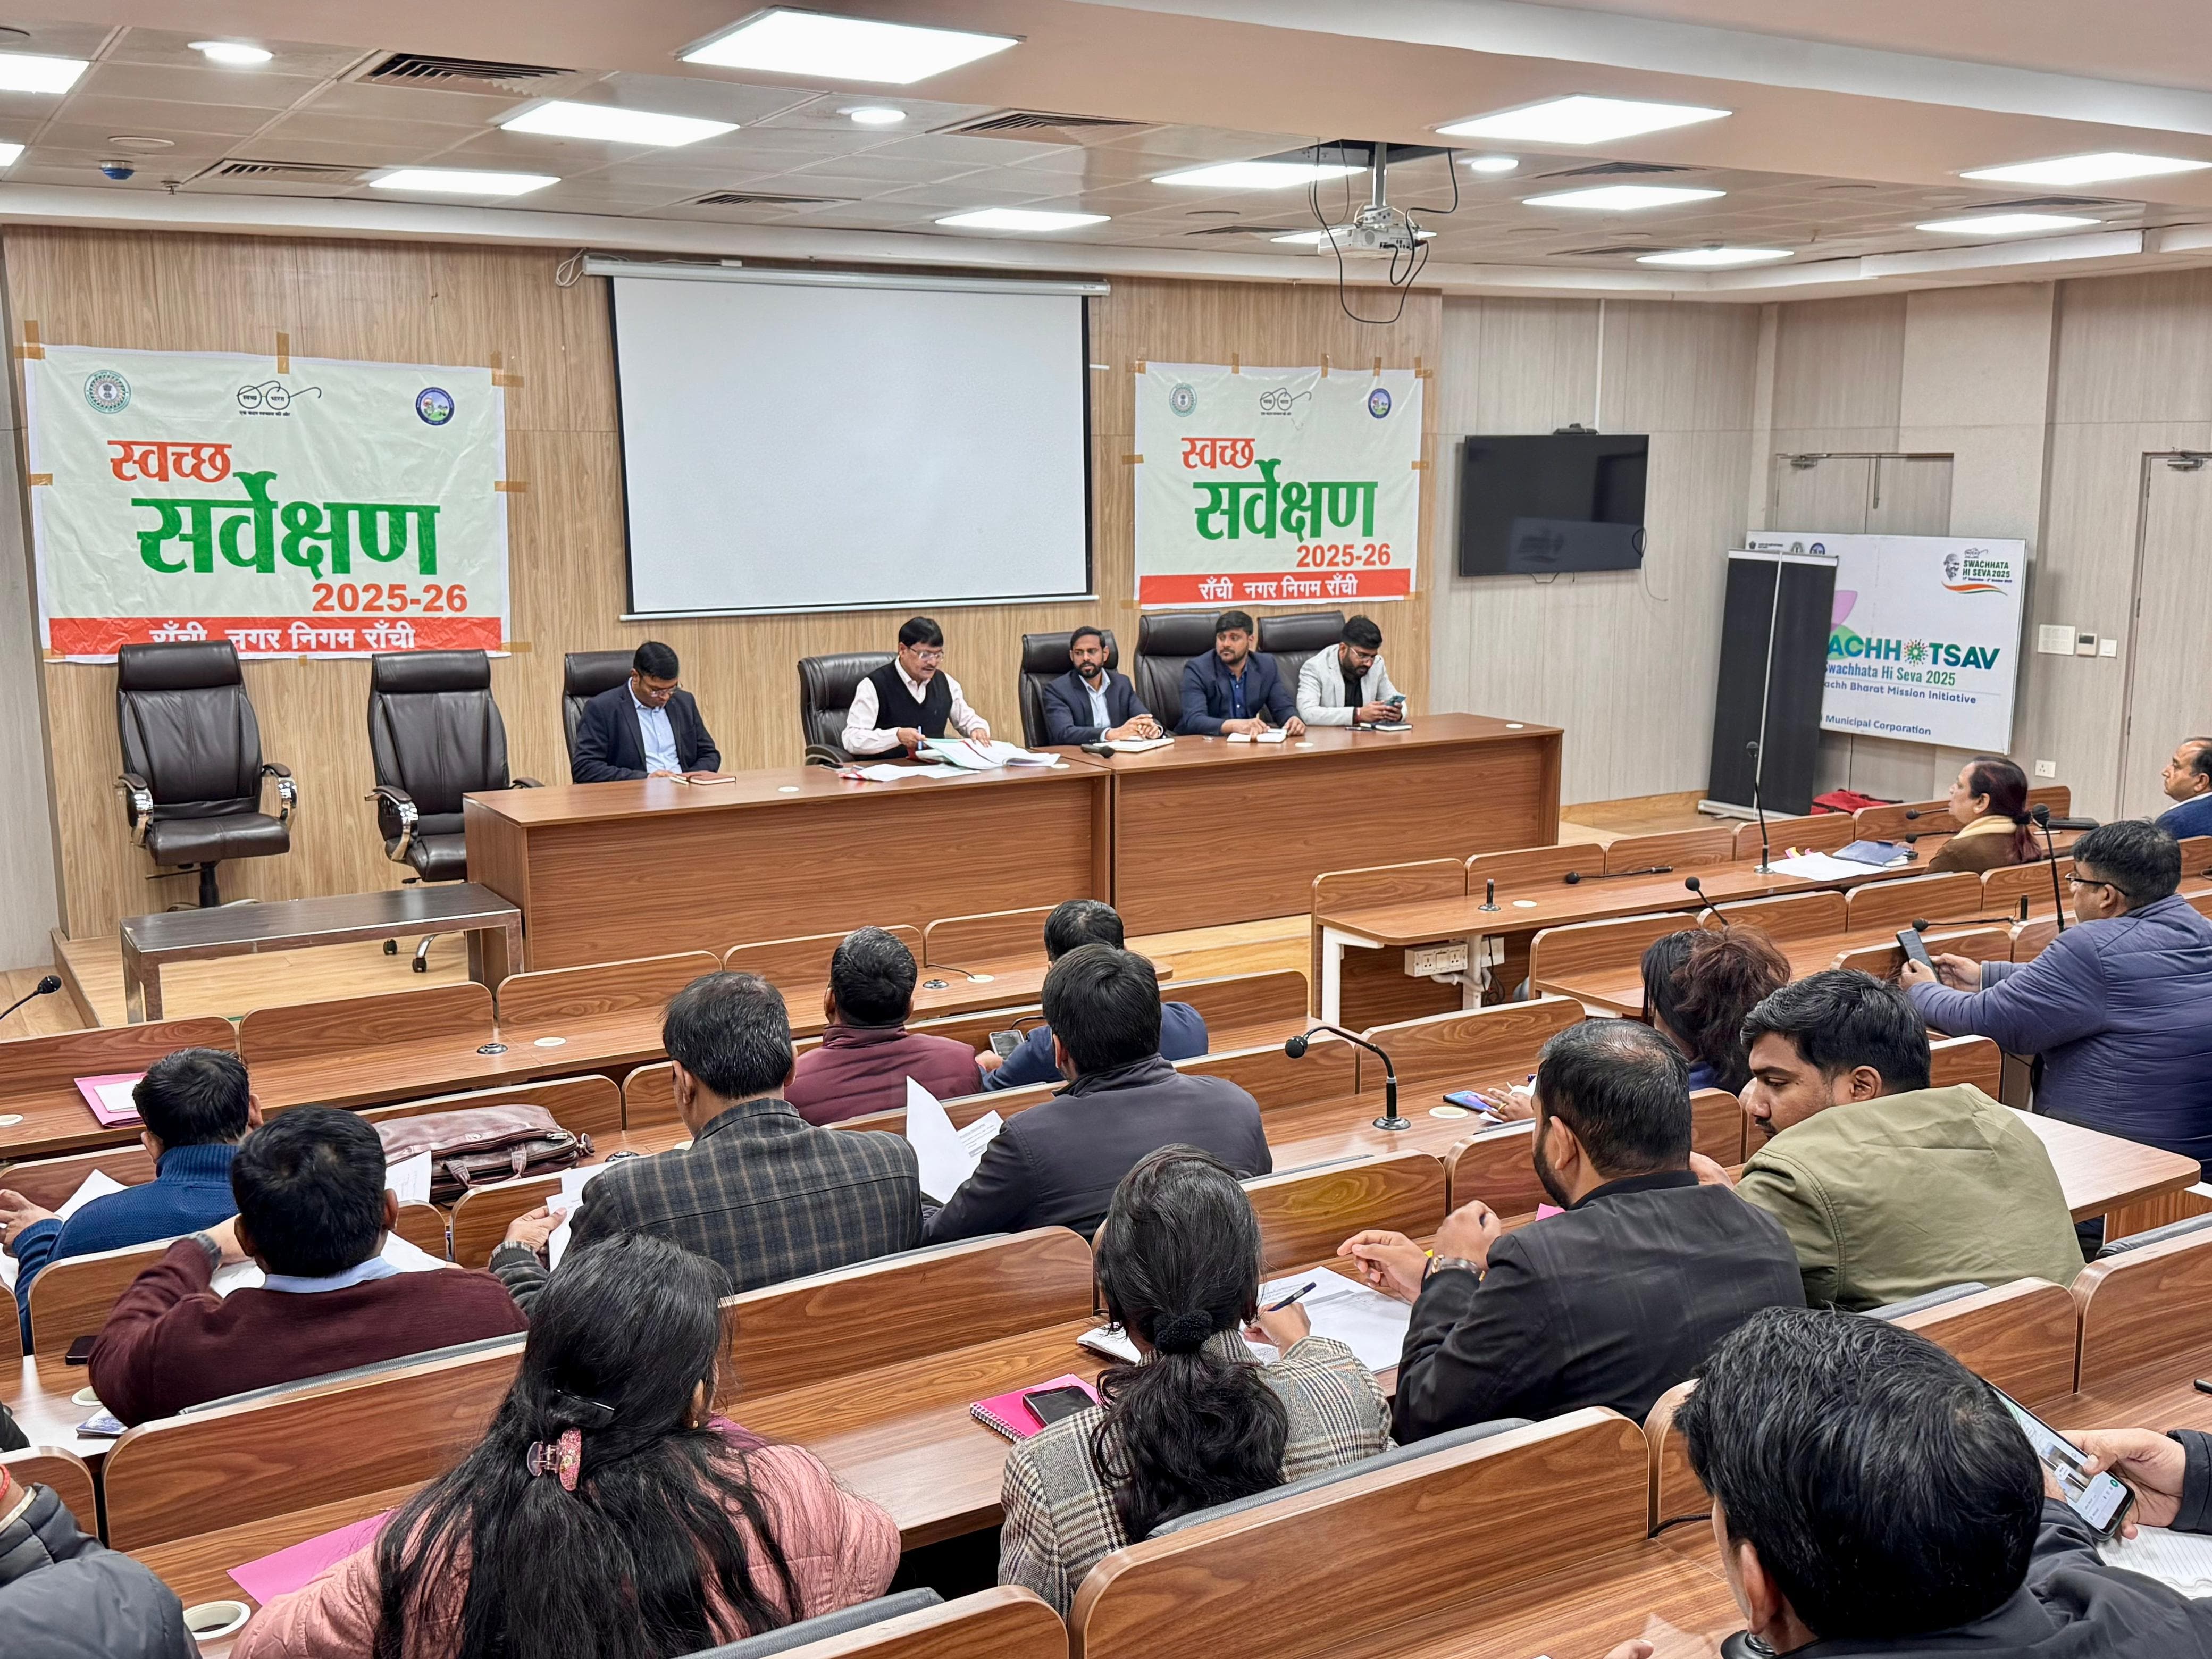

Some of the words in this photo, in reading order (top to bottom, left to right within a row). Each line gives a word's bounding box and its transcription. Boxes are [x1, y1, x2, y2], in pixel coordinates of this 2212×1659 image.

[108, 440, 232, 483] स्वच्छ
[1181, 437, 1255, 470] स्वच्छ
[1193, 458, 1378, 543] सर्वेक्षण
[131, 471, 441, 580] सर्वेक्षण
[1296, 543, 1391, 568] 2025-26
[1963, 560, 2009, 569] SWACHHATA
[1199, 576, 1234, 600] राँची
[1243, 582, 1277, 599] नगर
[1281, 575, 1322, 598] निगम
[1325, 572, 1358, 596] राँची
[1972, 569, 1991, 577] SEVA
[1992, 570, 2010, 579] 2025
[312, 583, 468, 613] 2025-26
[288, 621, 356, 649] निगम
[362, 619, 416, 649] राँची
[1881, 666, 1893, 680] Hi
[1897, 667, 1922, 683] Seva
[1926, 671, 1956, 686] 2025
[1850, 682, 1884, 694] Bharat
[1887, 686, 1925, 699] Mission
[1928, 690, 1976, 704] Initiative
[1825, 714, 1872, 728] Municipal
[1873, 720, 1931, 736] Corporation
